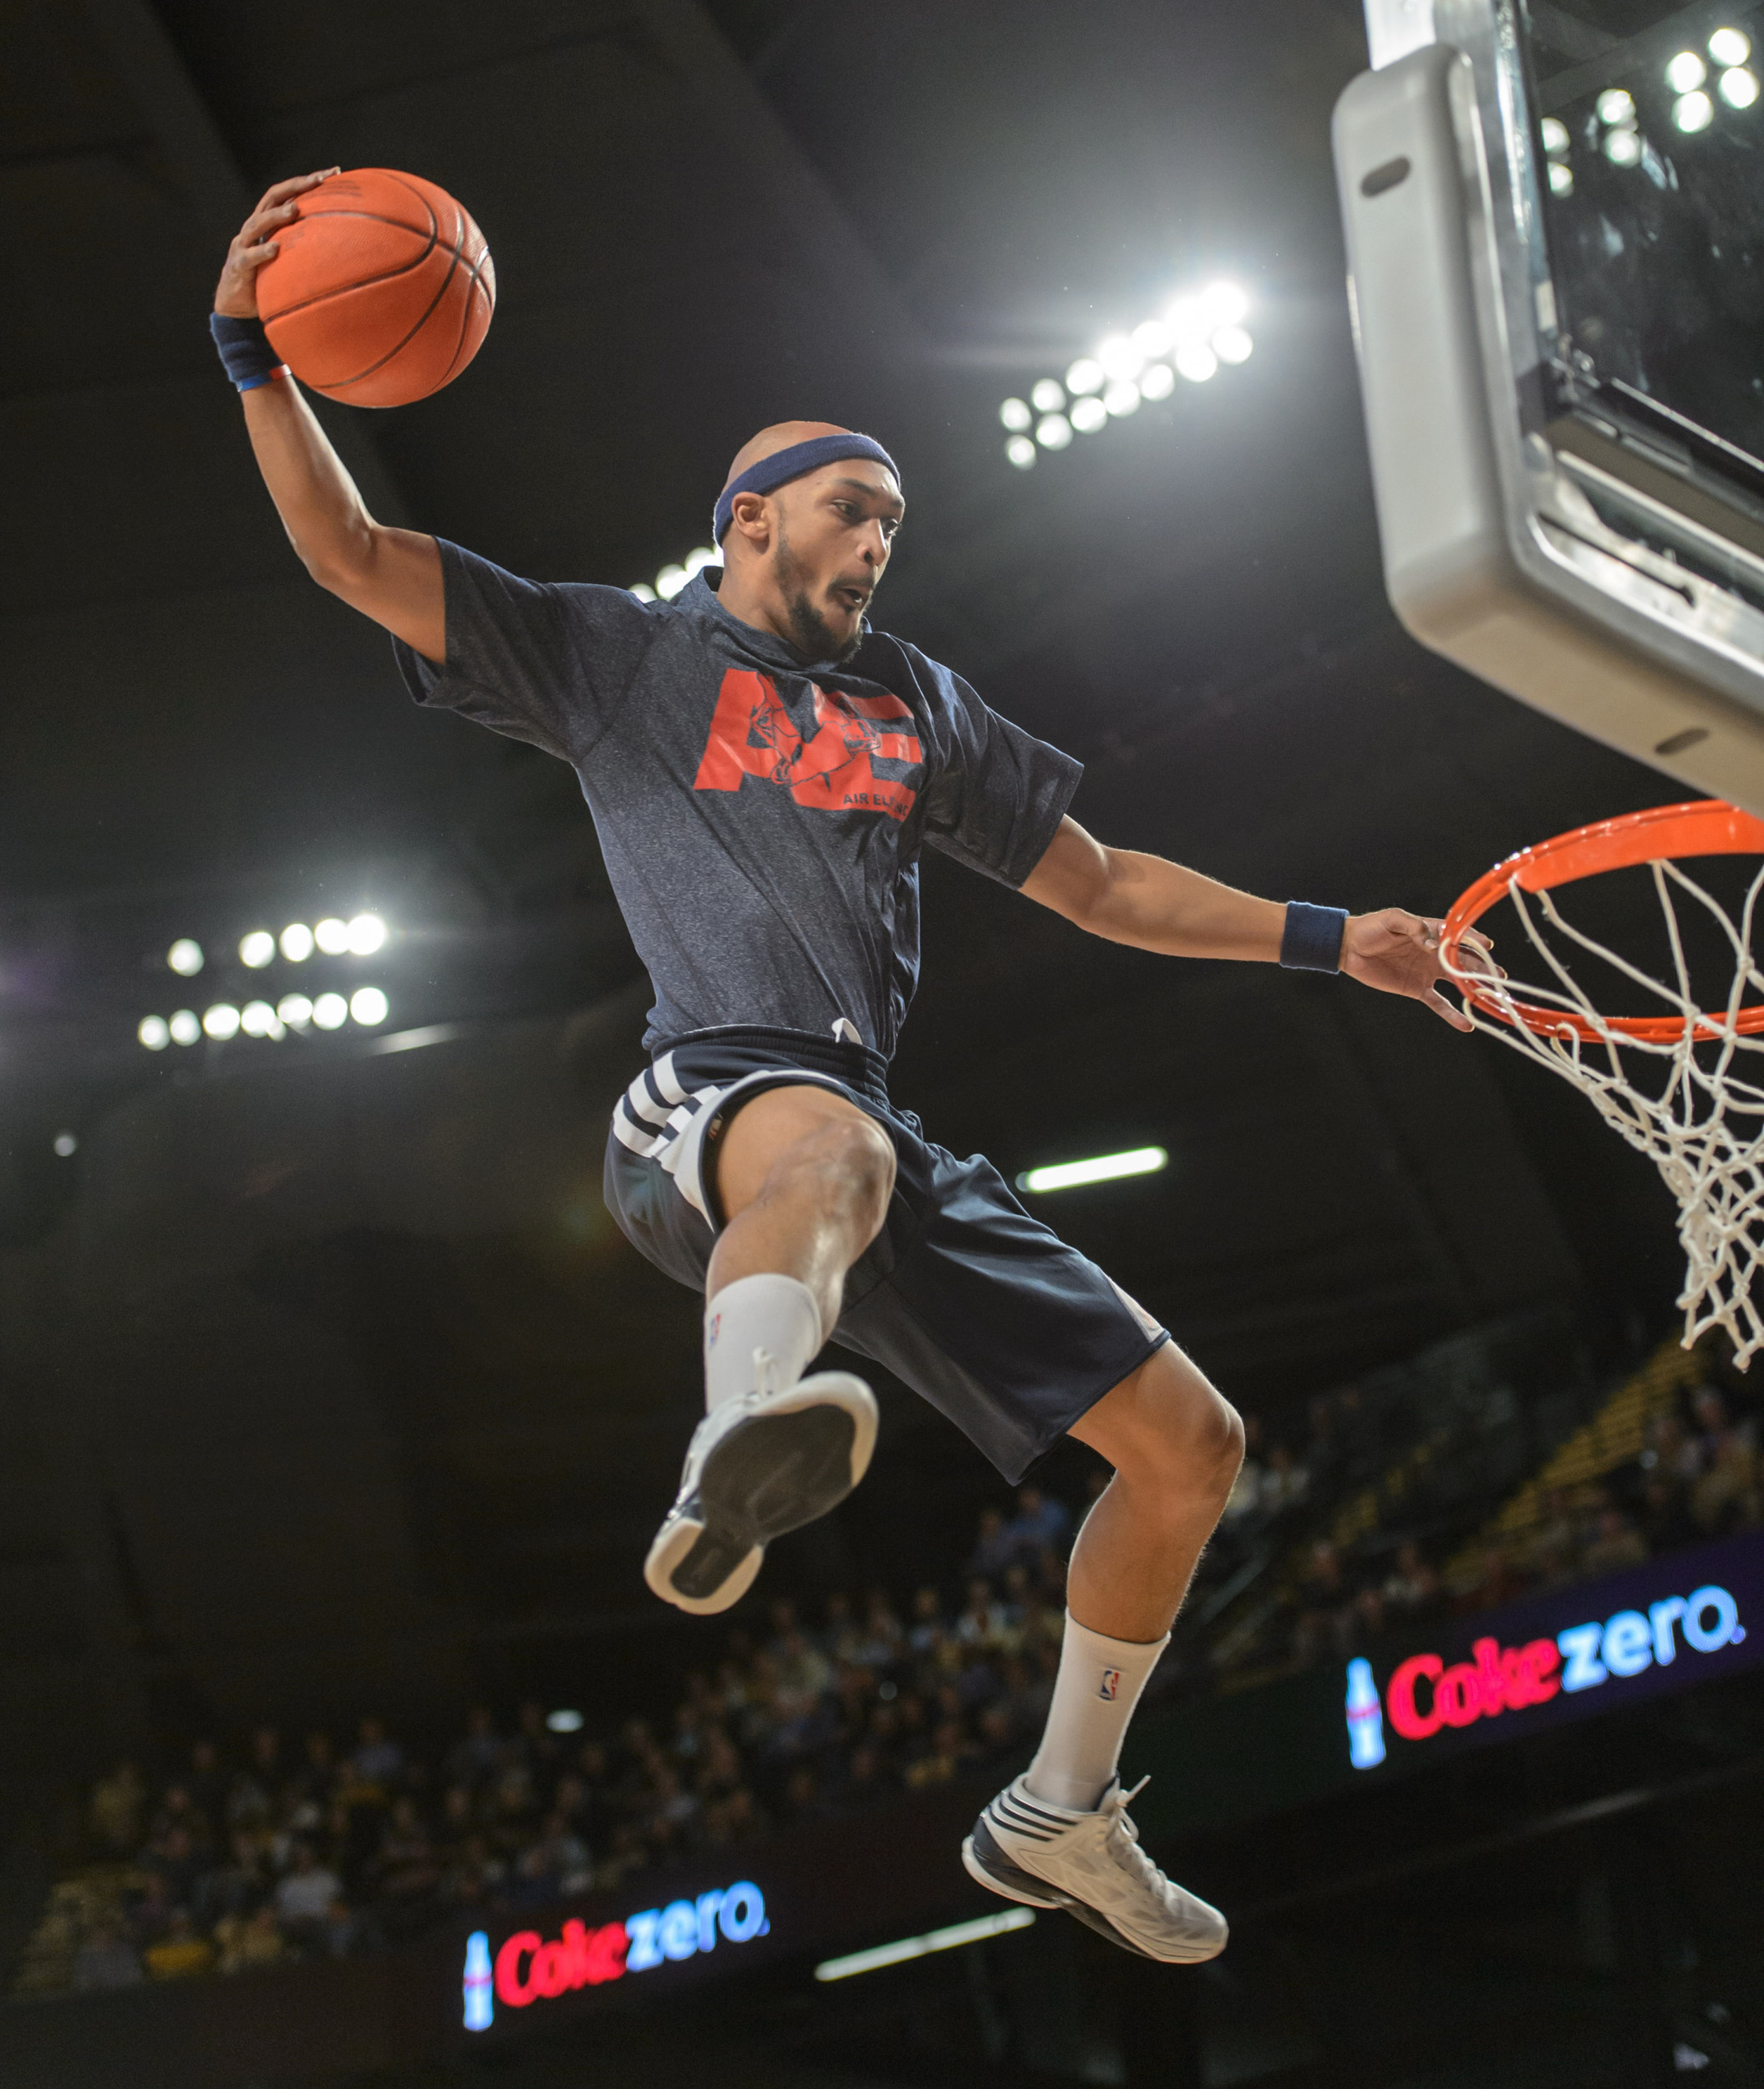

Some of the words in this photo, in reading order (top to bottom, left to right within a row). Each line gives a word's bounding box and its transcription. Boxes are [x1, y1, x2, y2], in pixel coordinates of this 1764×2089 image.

[843, 793, 868, 805] AIR
[1387, 1637, 1560, 1740] Coke
[495, 1919, 627, 2007] Coke
